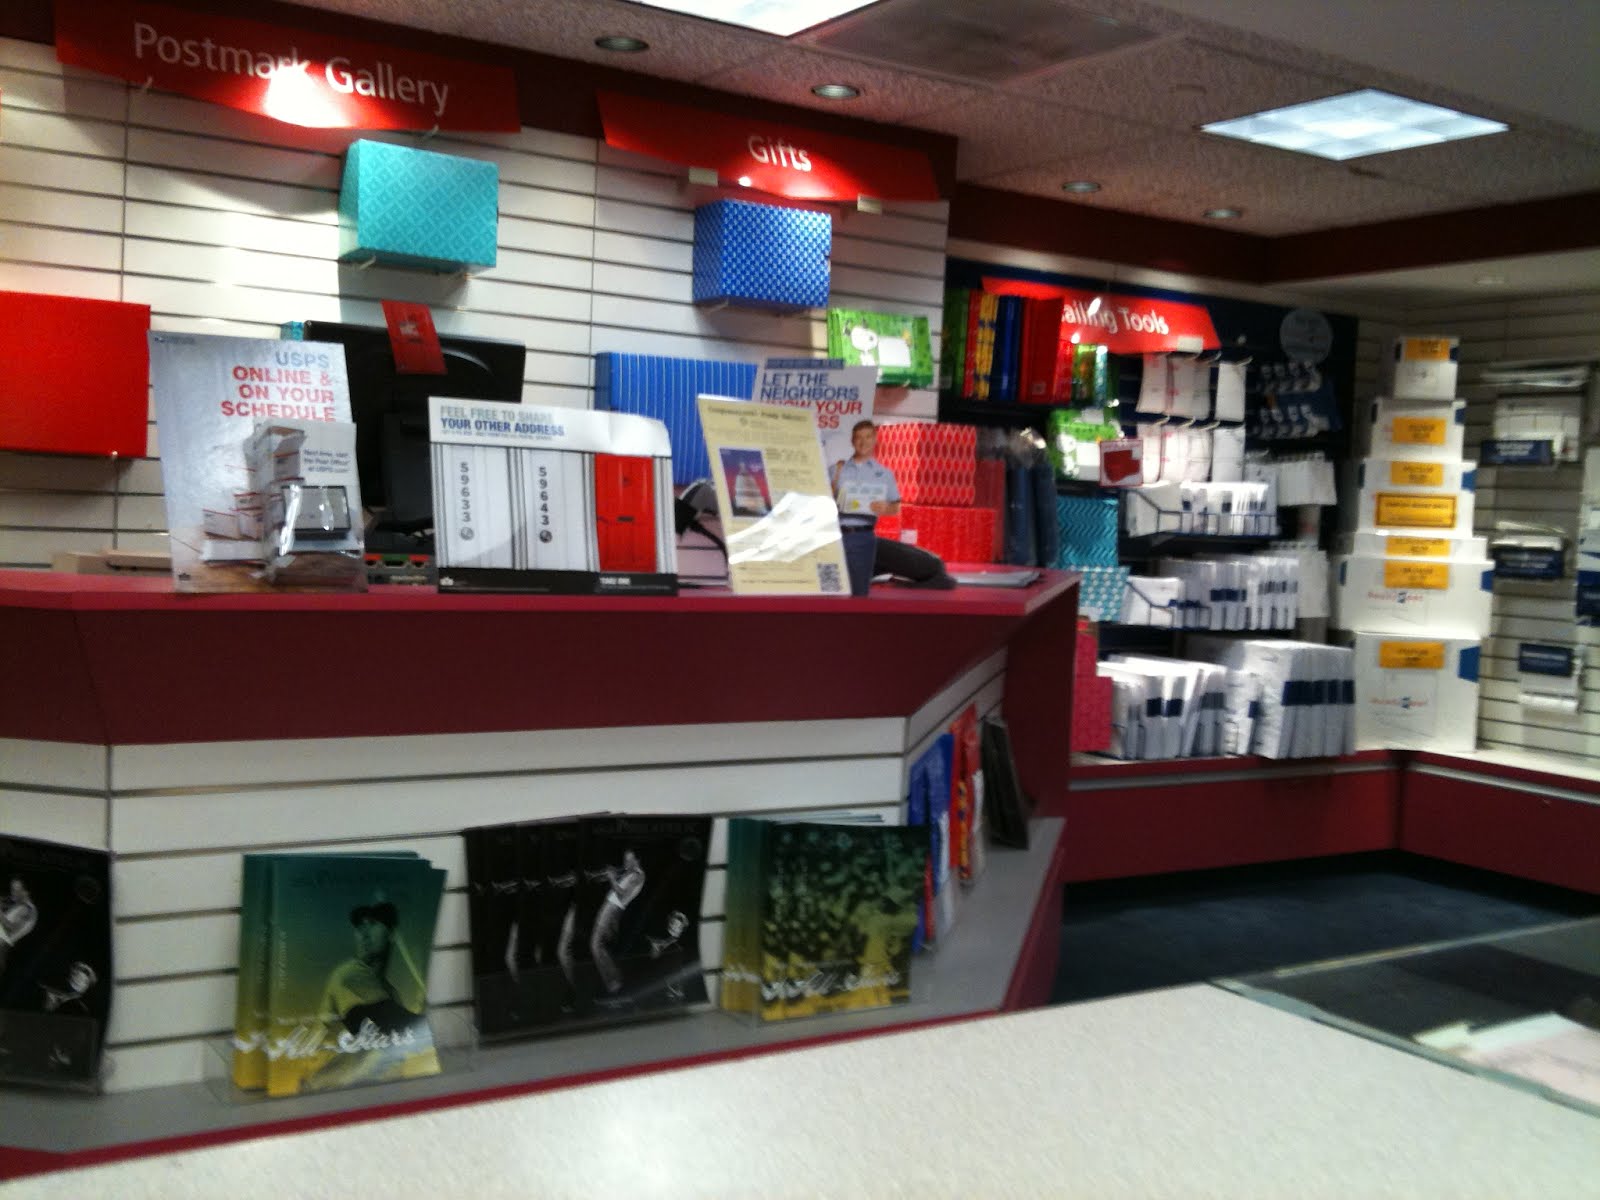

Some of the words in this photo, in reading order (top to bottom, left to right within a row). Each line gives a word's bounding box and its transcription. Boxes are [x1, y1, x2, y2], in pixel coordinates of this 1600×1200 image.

[133, 21, 311, 80] Postmark
[324, 55, 449, 117] Gallery
[748, 135, 812, 172] Gifts
[1061, 299, 1118, 334] ailing
[1117, 306, 1170, 335] Tools
[275, 351, 330, 369] USPS
[232, 365, 312, 385] ONLINE
[319, 371, 333, 387] &
[762, 372, 791, 387] LET
[798, 372, 829, 387] THE
[238, 383, 270, 400] ON
[277, 386, 335, 405] YOUR
[760, 385, 860, 402] NEIGHBORS
[220, 400, 337, 422] SCHEDULE
[440, 405, 465, 418] FEEL
[470, 407, 498, 420] FREE
[500, 409, 516, 422] TO
[815, 400, 864, 416] YOUR
[440, 417, 472, 431] YOUR
[474, 419, 512, 433] OTHER
[514, 422, 566, 437] ADDRESS
